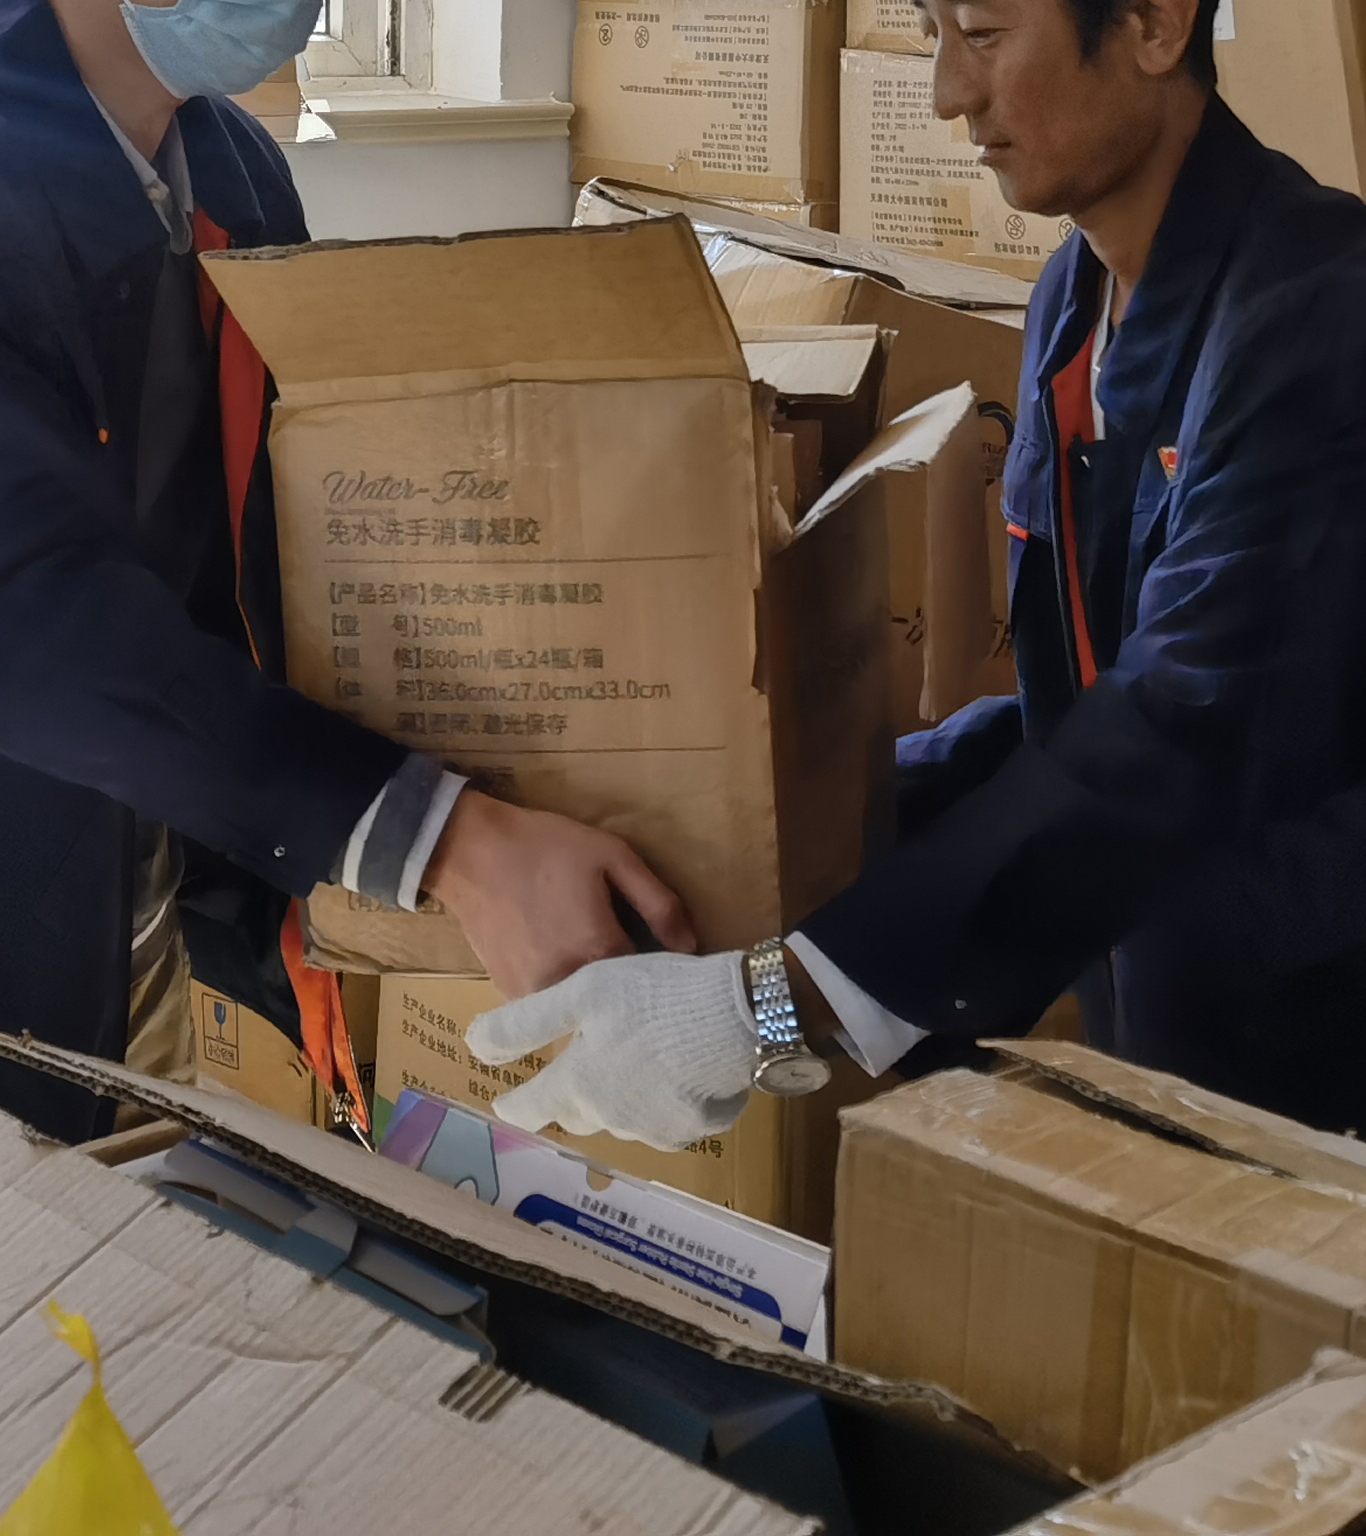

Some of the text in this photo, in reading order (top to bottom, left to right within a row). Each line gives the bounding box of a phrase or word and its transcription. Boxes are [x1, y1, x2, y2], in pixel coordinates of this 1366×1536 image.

[327, 517, 541, 547] 免水洗手消毒凝胶
